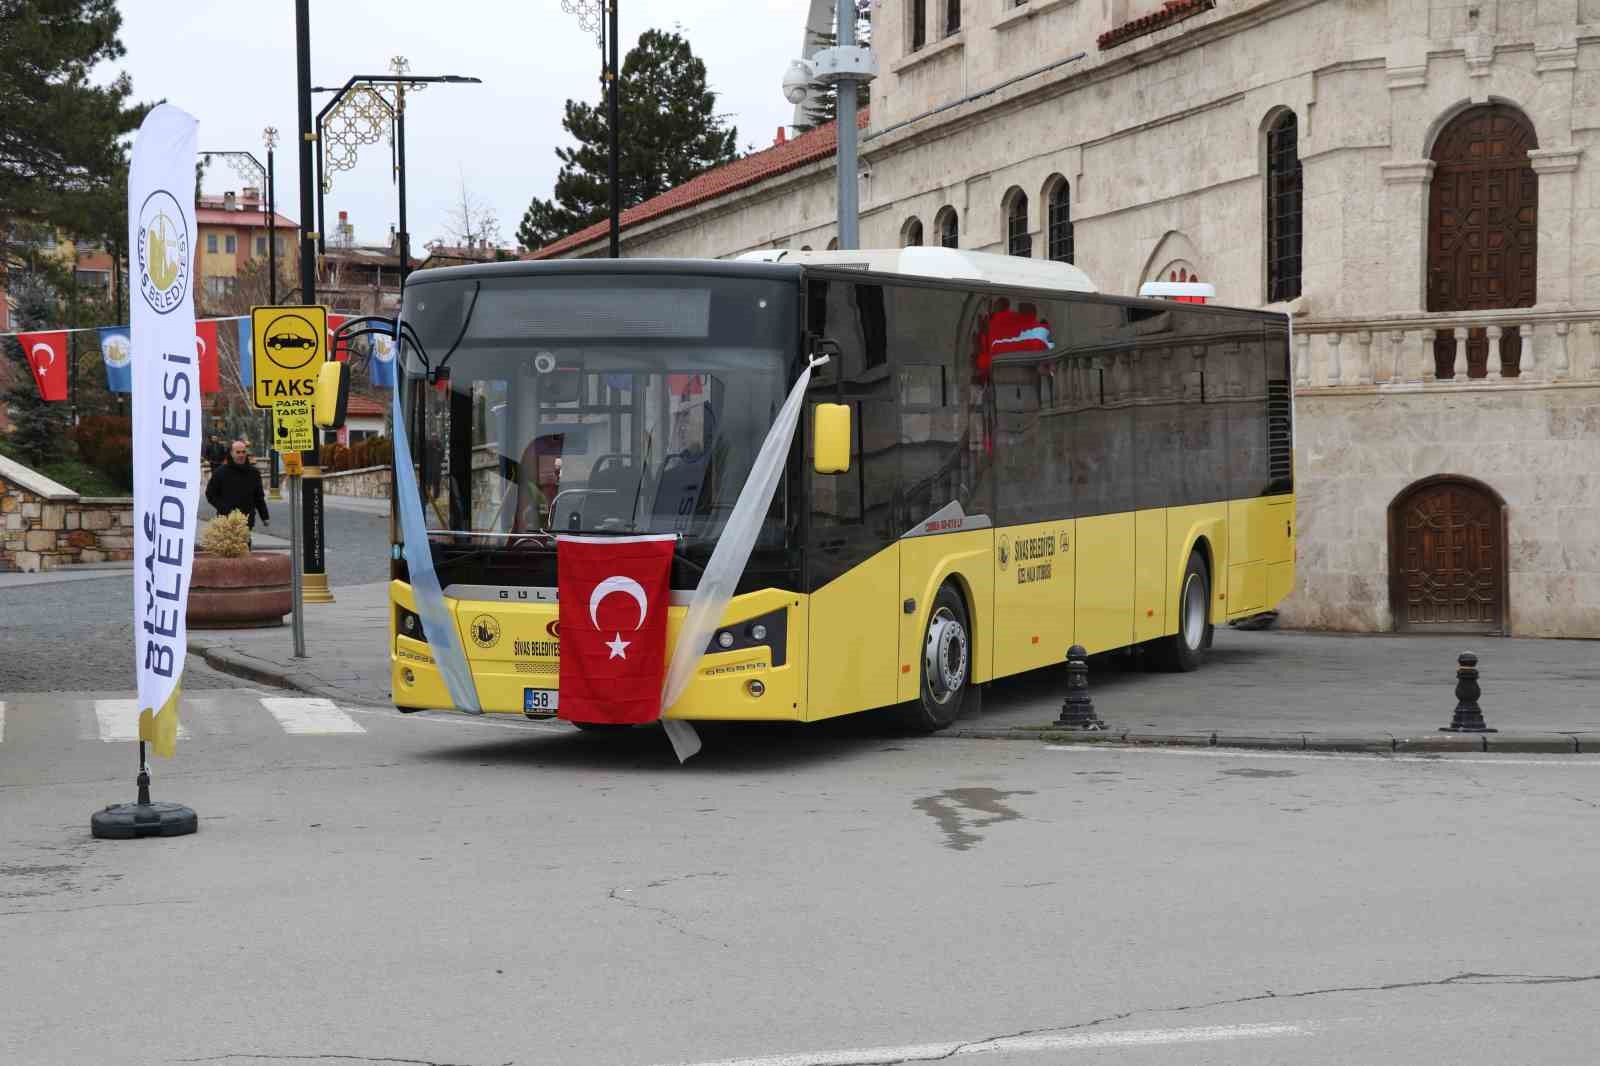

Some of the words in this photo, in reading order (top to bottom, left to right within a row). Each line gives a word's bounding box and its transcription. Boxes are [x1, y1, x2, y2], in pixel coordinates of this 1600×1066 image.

[261, 375, 319, 396] TAKS
[276, 399, 308, 407] PARK
[533, 691, 548, 707] 58
